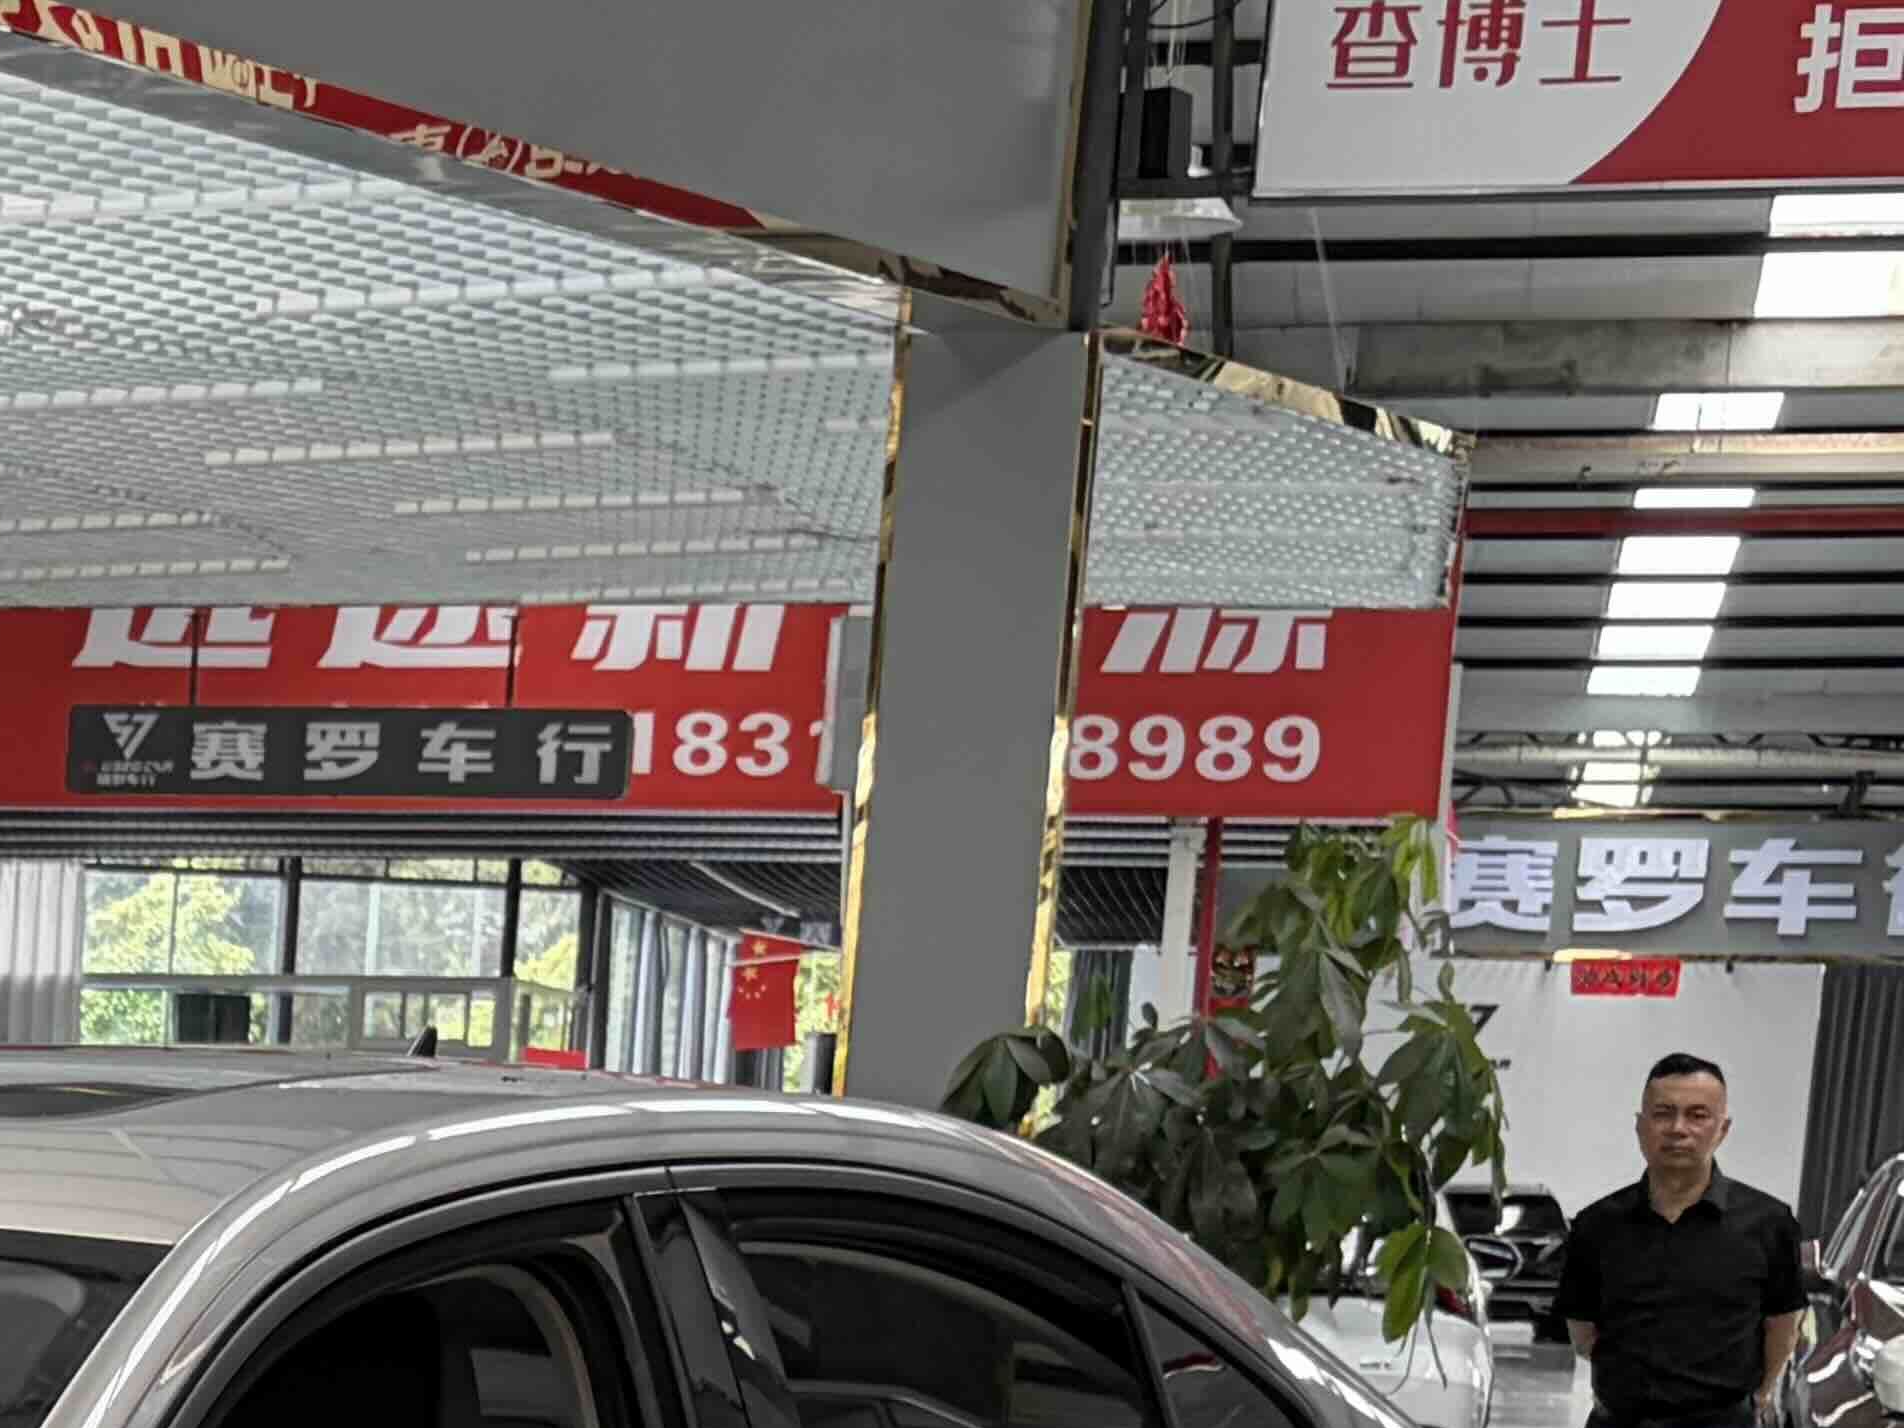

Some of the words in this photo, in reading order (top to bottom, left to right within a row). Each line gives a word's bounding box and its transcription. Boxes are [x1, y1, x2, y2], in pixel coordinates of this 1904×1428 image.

[1326, 0, 1632, 88] 查博士
[190, 720, 613, 784] 赛罗车行
[1449, 836, 1904, 936] 赛罗车
